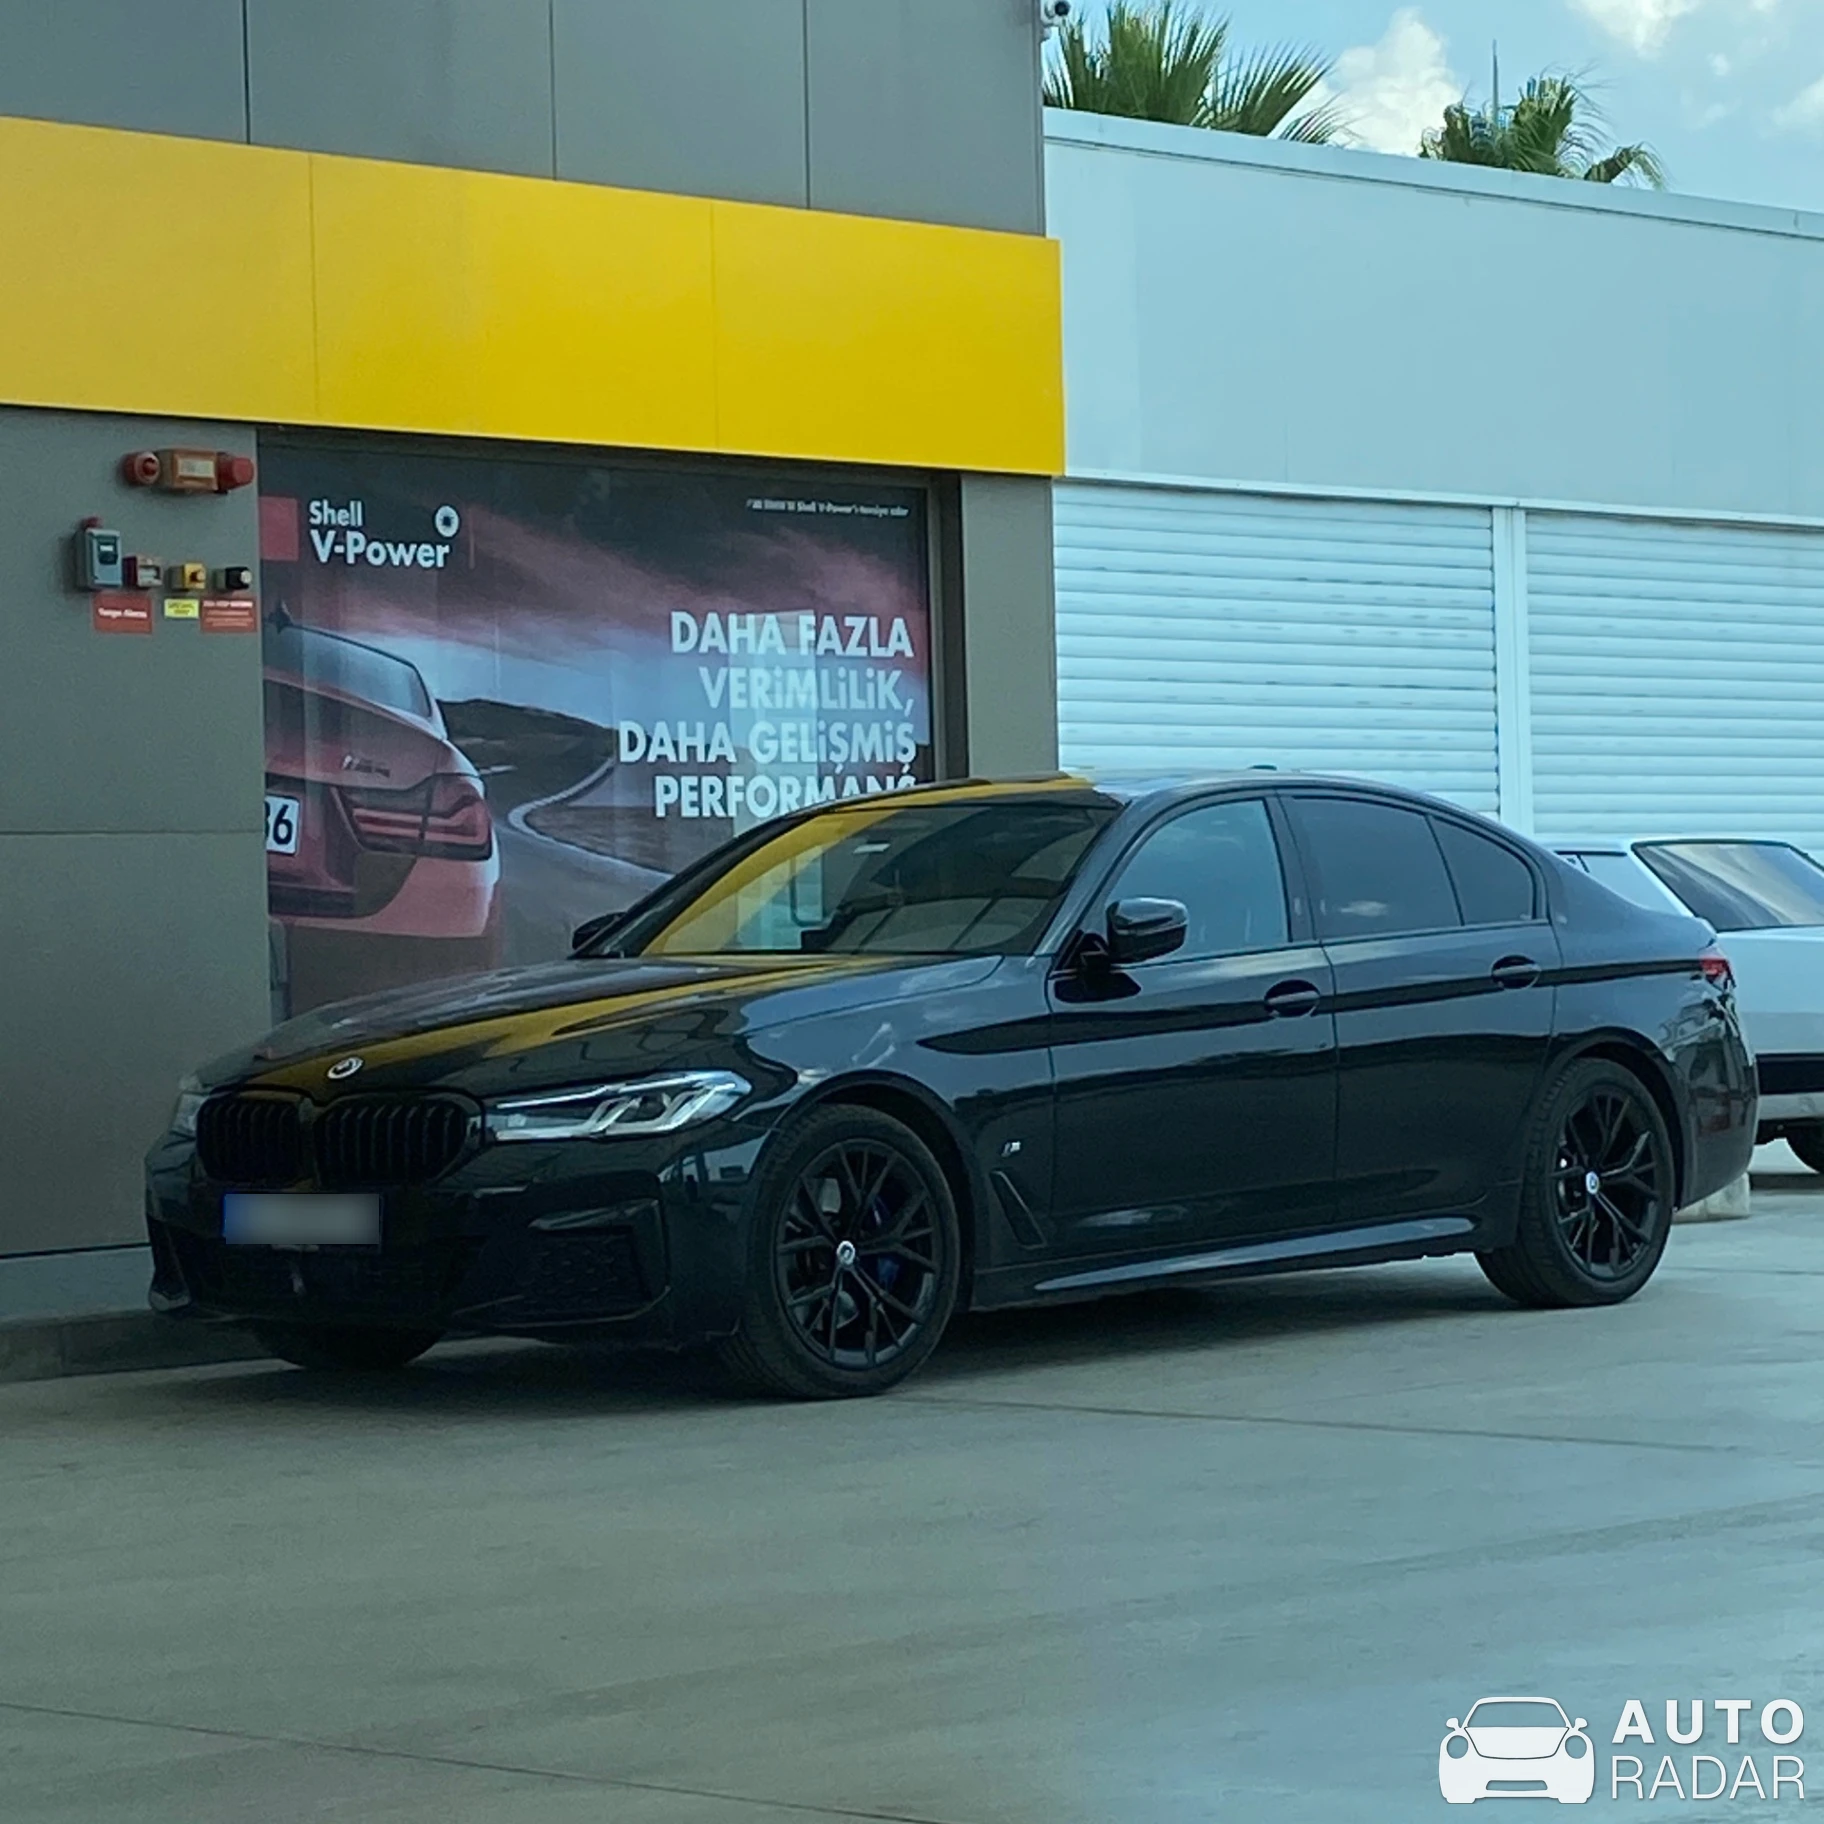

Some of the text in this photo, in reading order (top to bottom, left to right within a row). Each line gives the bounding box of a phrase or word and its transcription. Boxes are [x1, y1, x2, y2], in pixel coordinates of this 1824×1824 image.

[309, 499, 364, 527] Shell
[310, 529, 451, 569] V-Power
[671, 611, 914, 658] DAHA FAZLA
[618, 720, 738, 764] DAHA
